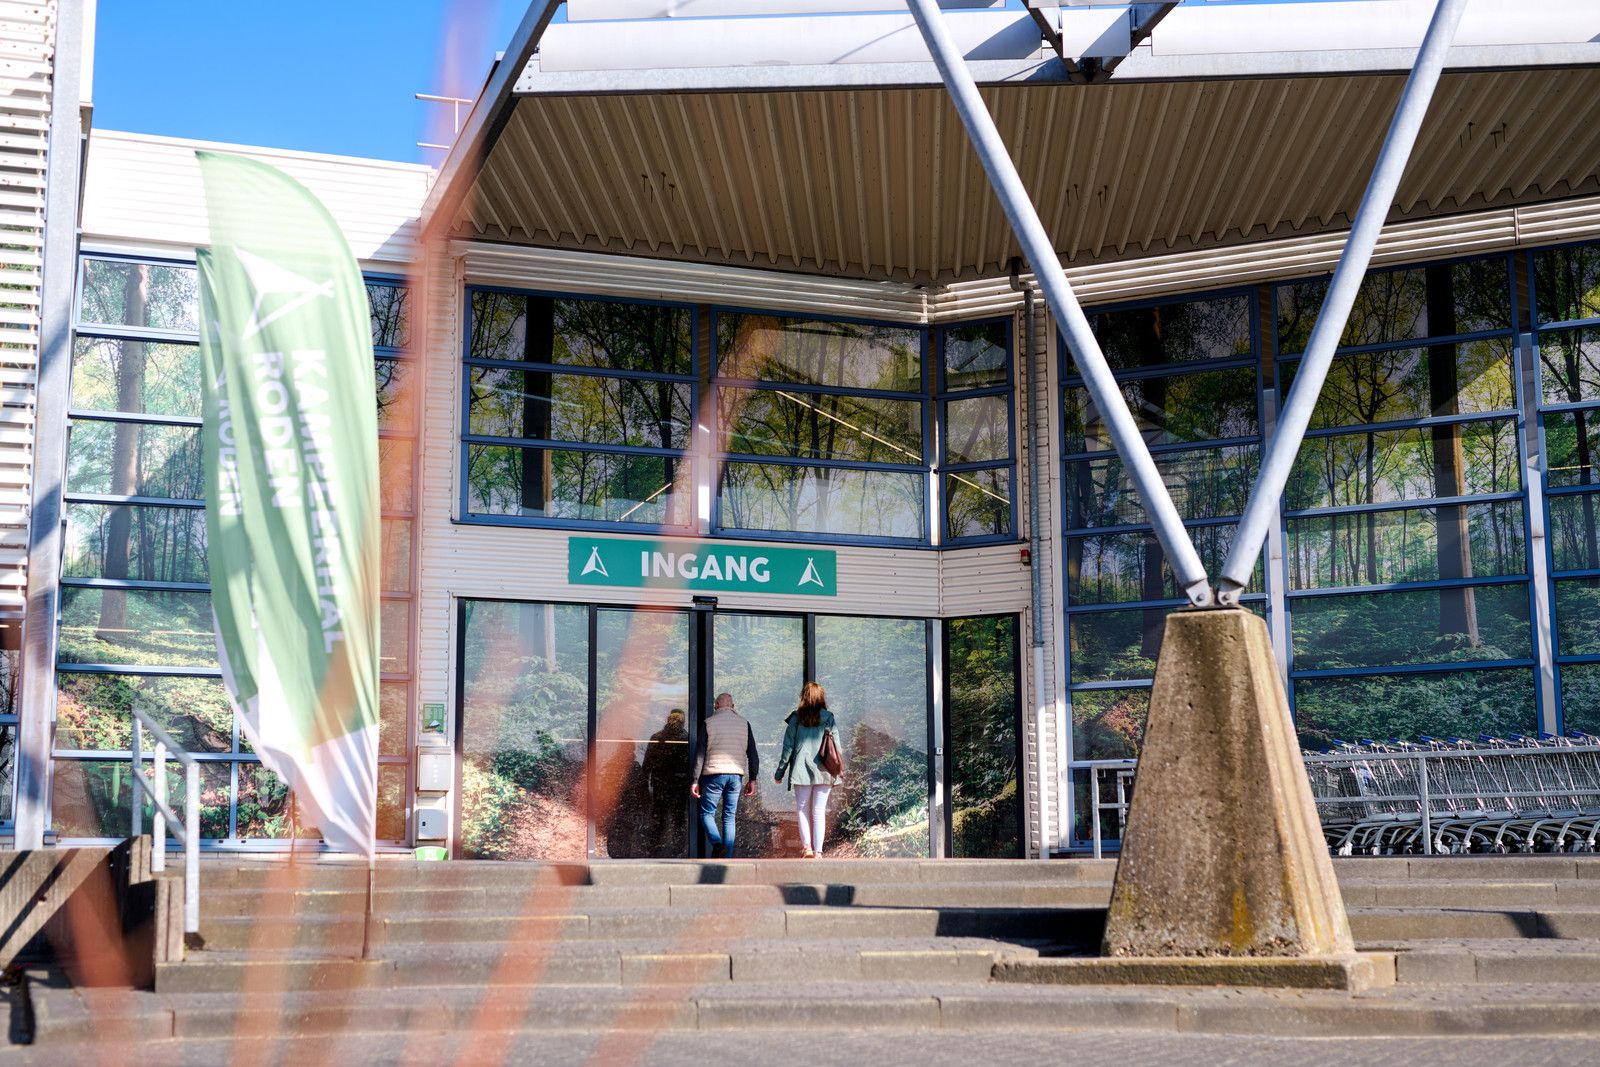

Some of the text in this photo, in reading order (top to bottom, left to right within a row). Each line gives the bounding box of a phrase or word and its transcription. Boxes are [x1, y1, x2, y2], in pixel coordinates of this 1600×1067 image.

[252, 352, 302, 507] RODEN
[292, 350, 345, 653] KAMPEERHAL
[641, 551, 770, 582] INGANG
